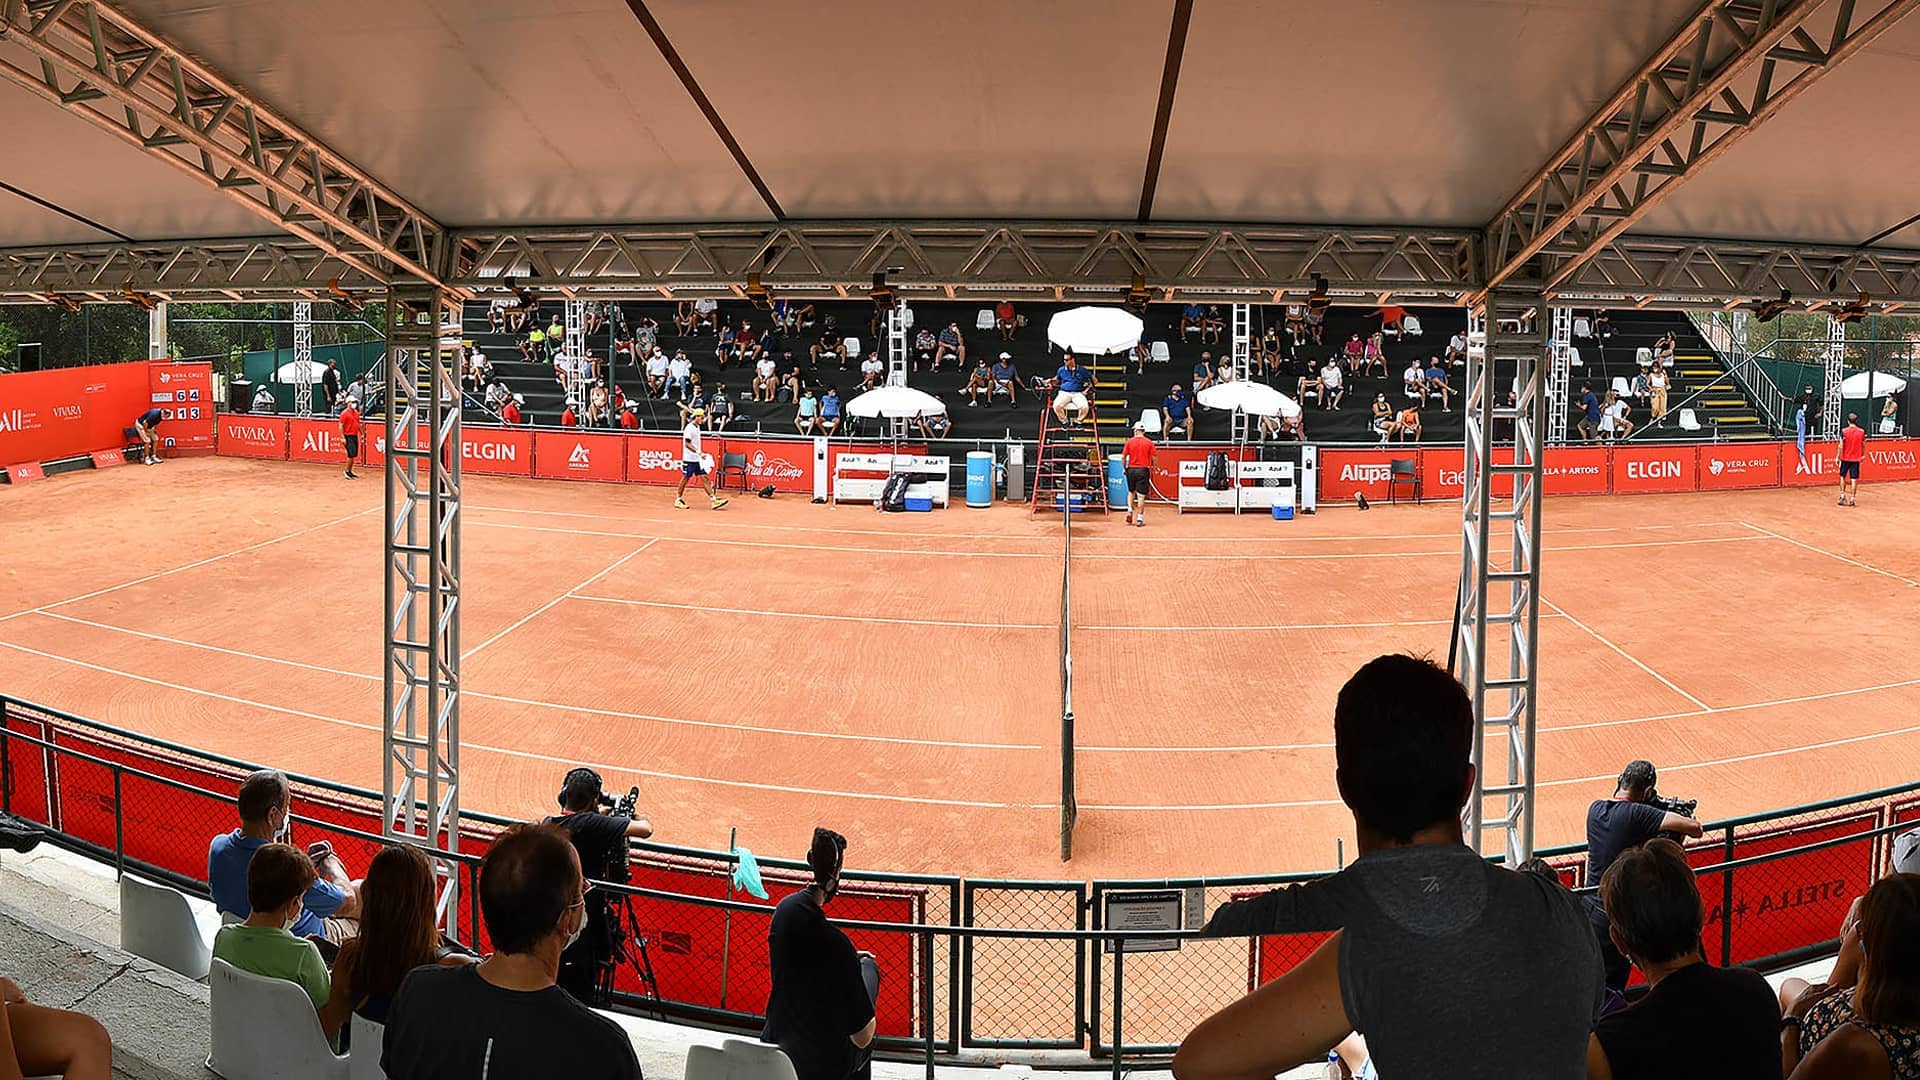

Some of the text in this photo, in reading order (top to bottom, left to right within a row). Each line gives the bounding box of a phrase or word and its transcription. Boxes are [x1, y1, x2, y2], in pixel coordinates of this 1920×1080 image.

[177, 392, 185, 400] 6
[191, 391, 198, 399] 4
[53, 405, 82, 417] VIVARA
[191, 409, 198, 418] 3
[228, 425, 275, 441] VIVARA
[303, 431, 330, 452] All
[462, 442, 516, 461] ELGIN
[639, 450, 672, 460] BAND
[1869, 450, 1917, 465] VIVARA
[639, 459, 683, 471] SPOR
[1627, 461, 1681, 478] ELGIN
[1748, 459, 1769, 467] CRUZ
[1795, 453, 1822, 475] All
[1340, 464, 1395, 484] Alupa
[1568, 466, 1599, 475] ARTOIS
